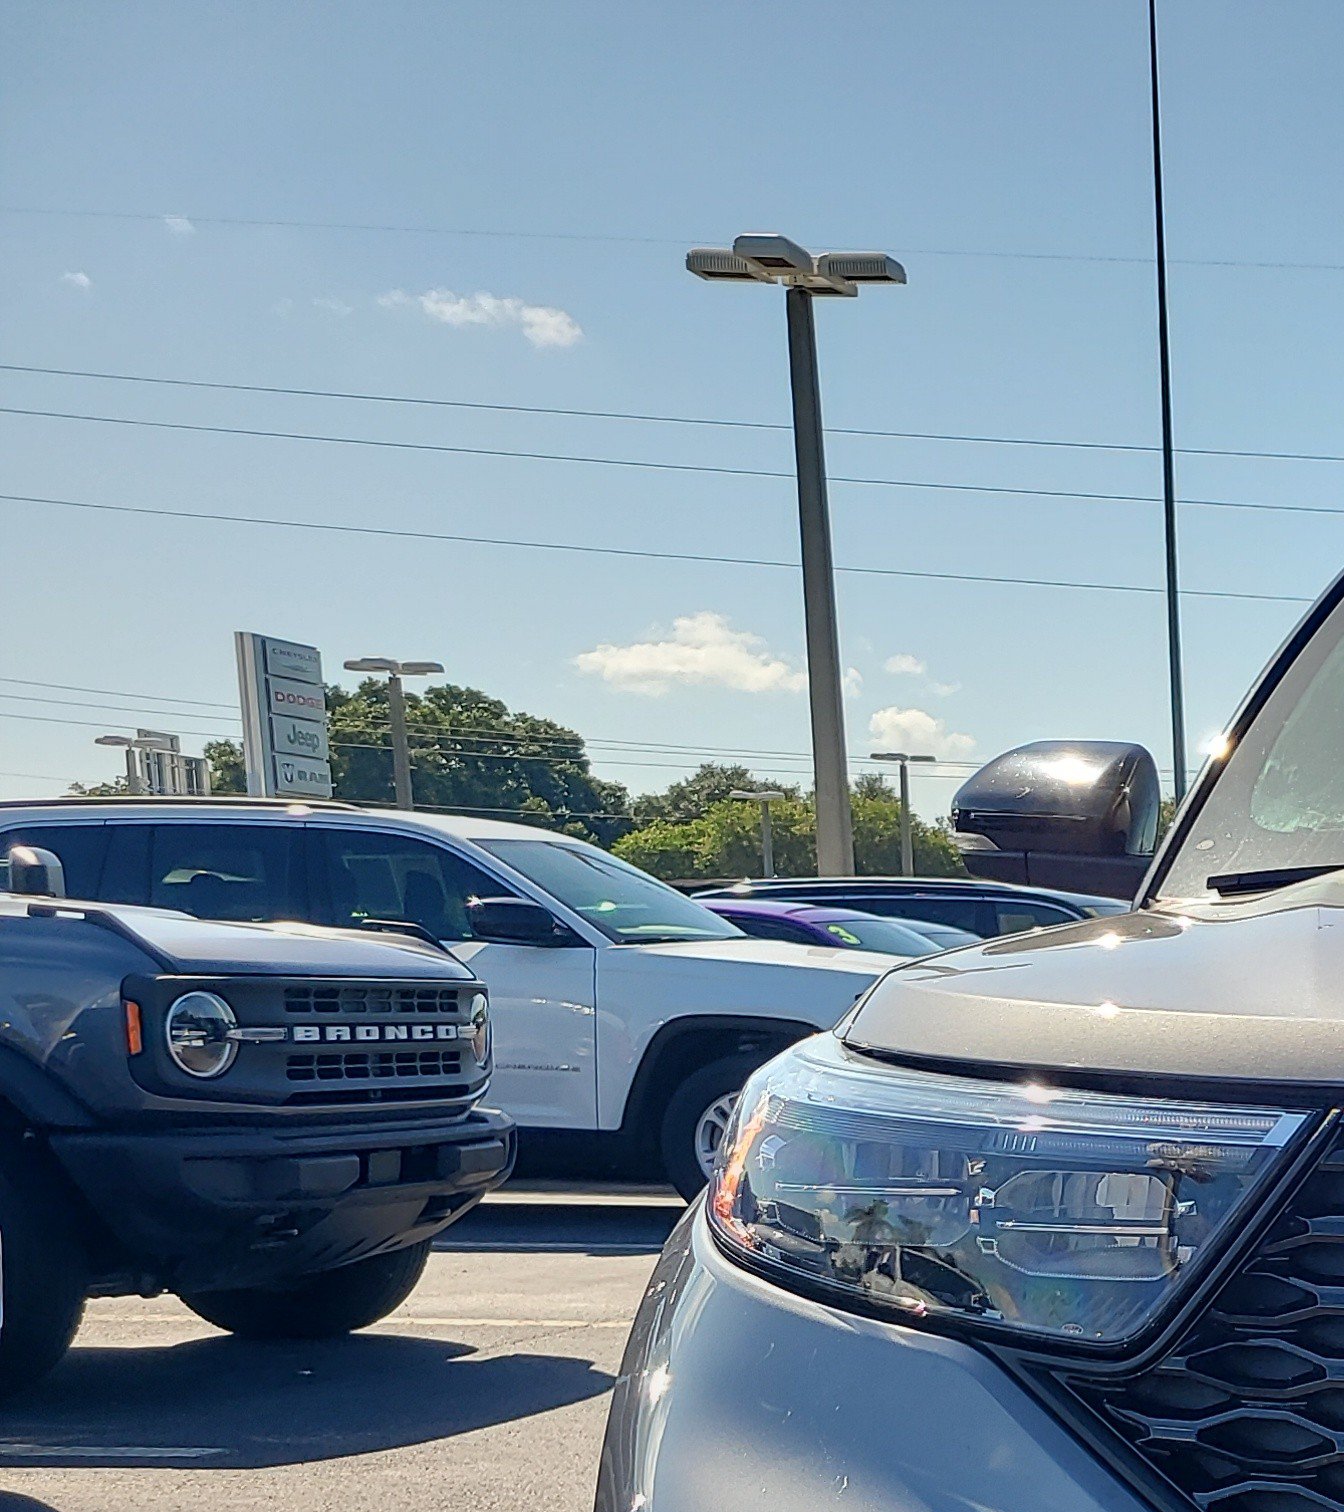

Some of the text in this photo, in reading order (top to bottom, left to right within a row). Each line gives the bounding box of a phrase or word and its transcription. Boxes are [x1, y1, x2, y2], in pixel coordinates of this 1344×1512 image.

[274, 690, 323, 709] DODGE
[286, 723, 320, 754] Jeep
[293, 1025, 458, 1042] BRONCO
